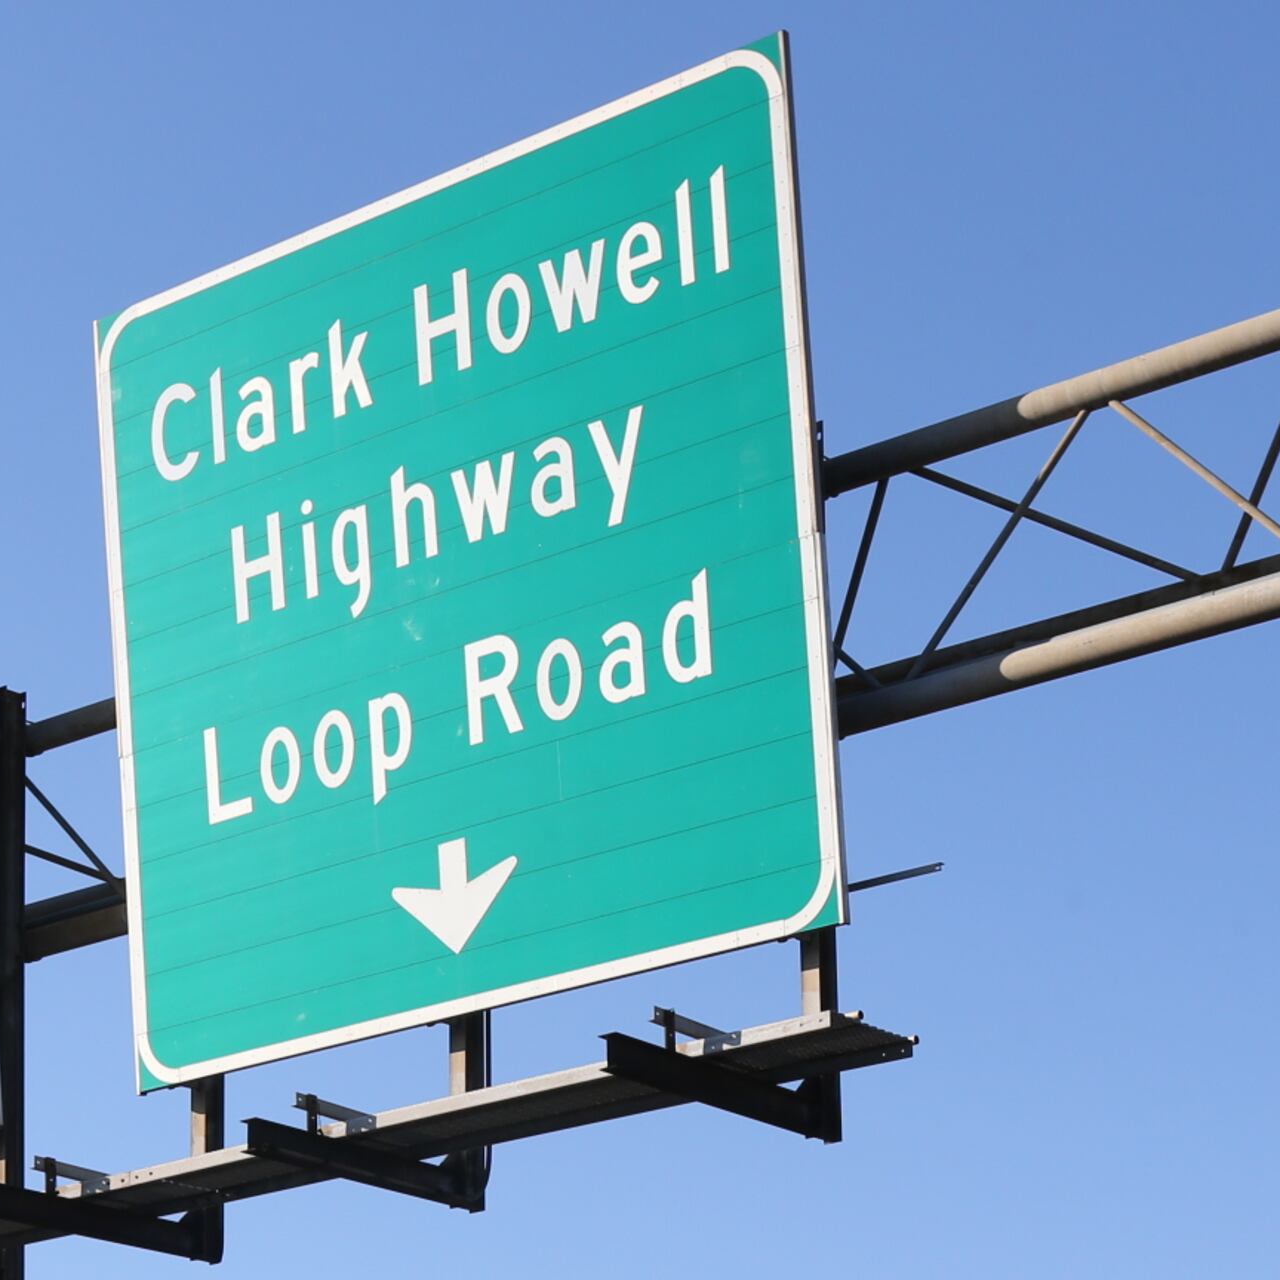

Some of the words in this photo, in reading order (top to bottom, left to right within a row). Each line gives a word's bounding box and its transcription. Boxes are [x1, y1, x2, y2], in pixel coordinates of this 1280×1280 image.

[151, 317, 374, 483] Clark
[413, 164, 730, 386] Howell
[230, 404, 643, 624] Highway
[203, 692, 413, 825] Loop
[463, 567, 713, 746] Road
